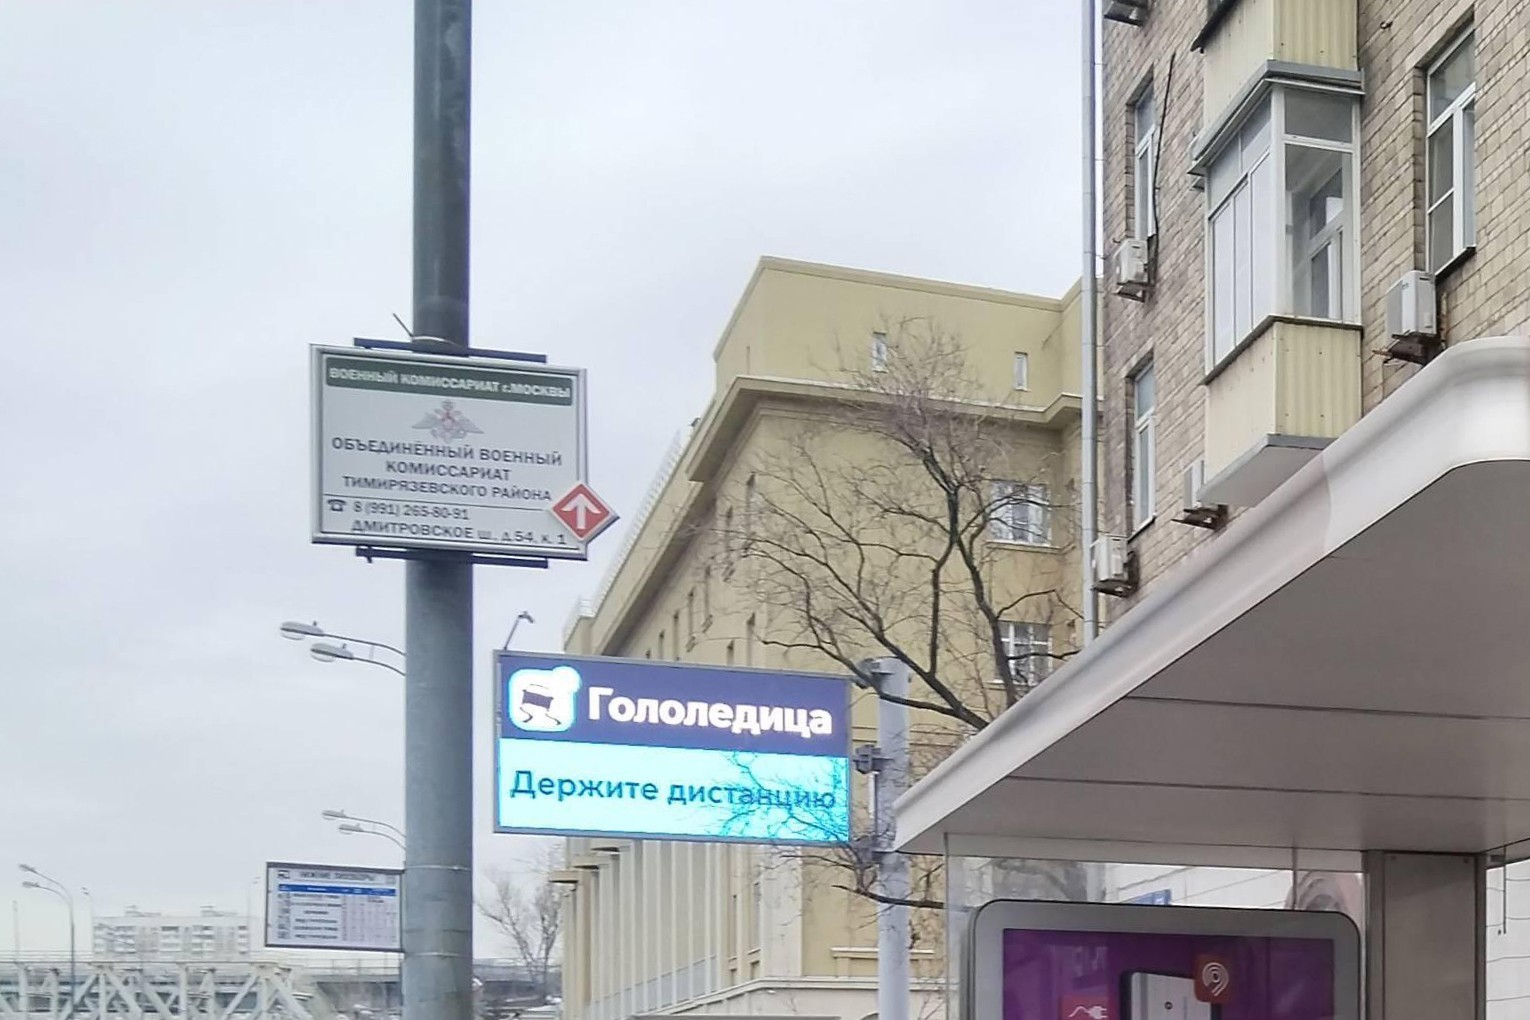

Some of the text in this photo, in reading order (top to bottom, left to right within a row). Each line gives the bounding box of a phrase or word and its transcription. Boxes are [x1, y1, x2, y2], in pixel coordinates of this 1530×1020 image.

[328, 366, 398, 384] ВОЕННЫЙ
[400, 373, 499, 393] КОМИССАРИАТ
[480, 448, 562, 466] ВОЕННЫЙ
[386, 461, 511, 481] КОМИССАРИАТ
[342, 475, 552, 501] ТИМИРЯЗЕВСКОГО РАЙОНА
[354, 501, 362, 512] 8
[352, 520, 473, 539] ДМИТРОВСКОЕ
[557, 534, 566, 544] 1
[588, 686, 833, 738] Гололедица
[510, 770, 836, 811] Держите дистанцию
